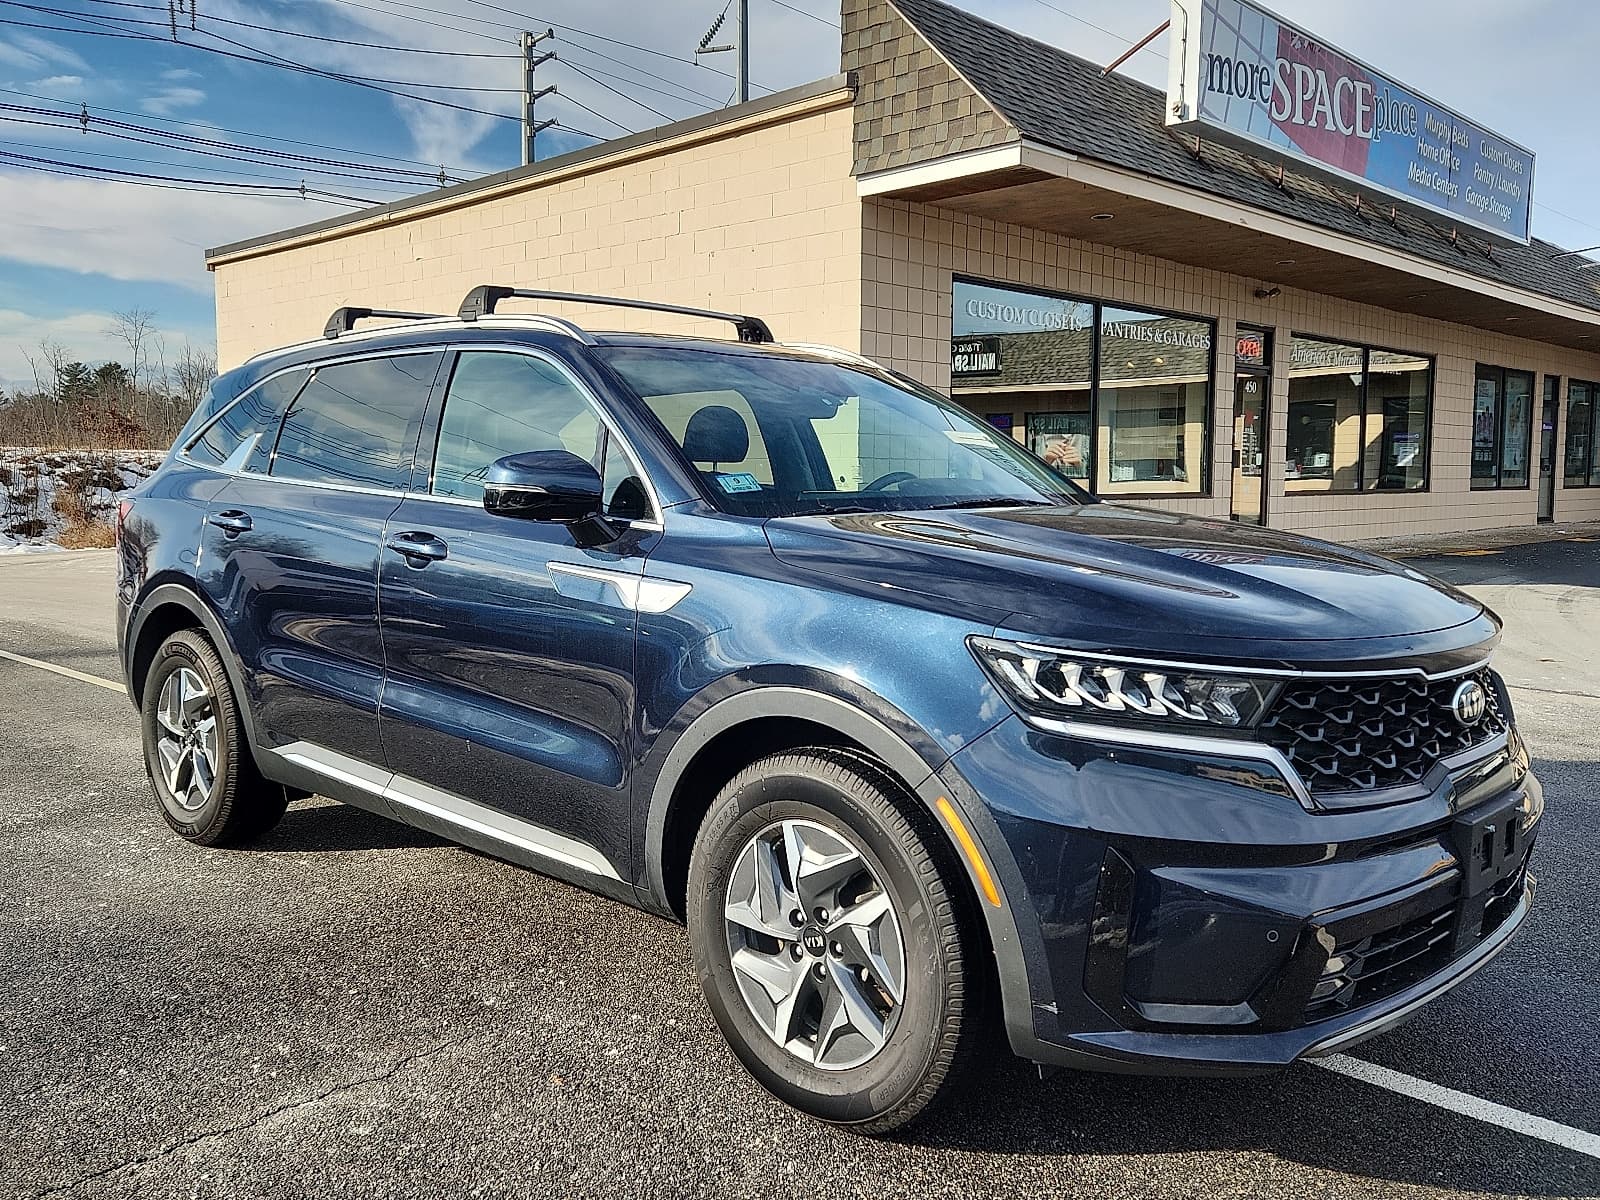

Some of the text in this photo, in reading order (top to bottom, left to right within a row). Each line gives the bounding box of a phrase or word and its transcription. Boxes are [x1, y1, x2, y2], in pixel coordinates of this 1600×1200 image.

[1424, 112, 1469, 148] Murphy Beds
[1417, 136, 1460, 171] Home Office
[1480, 140, 1523, 174] Custom Closets
[1408, 161, 1458, 198] Media Centers
[1473, 162, 1495, 189] Pantry
[1499, 174, 1521, 202] Laundry
[1465, 186, 1512, 222] Garage Storage
[966, 299, 1083, 331] CUSTOM CLOSETS
[1101, 321, 1211, 350] PANTRIES & GARAGES
[1237, 339, 1260, 357] OPEN
[1290, 344, 1334, 367] America's
[1245, 381, 1257, 394] 450
[804, 935, 825, 948] KIA
